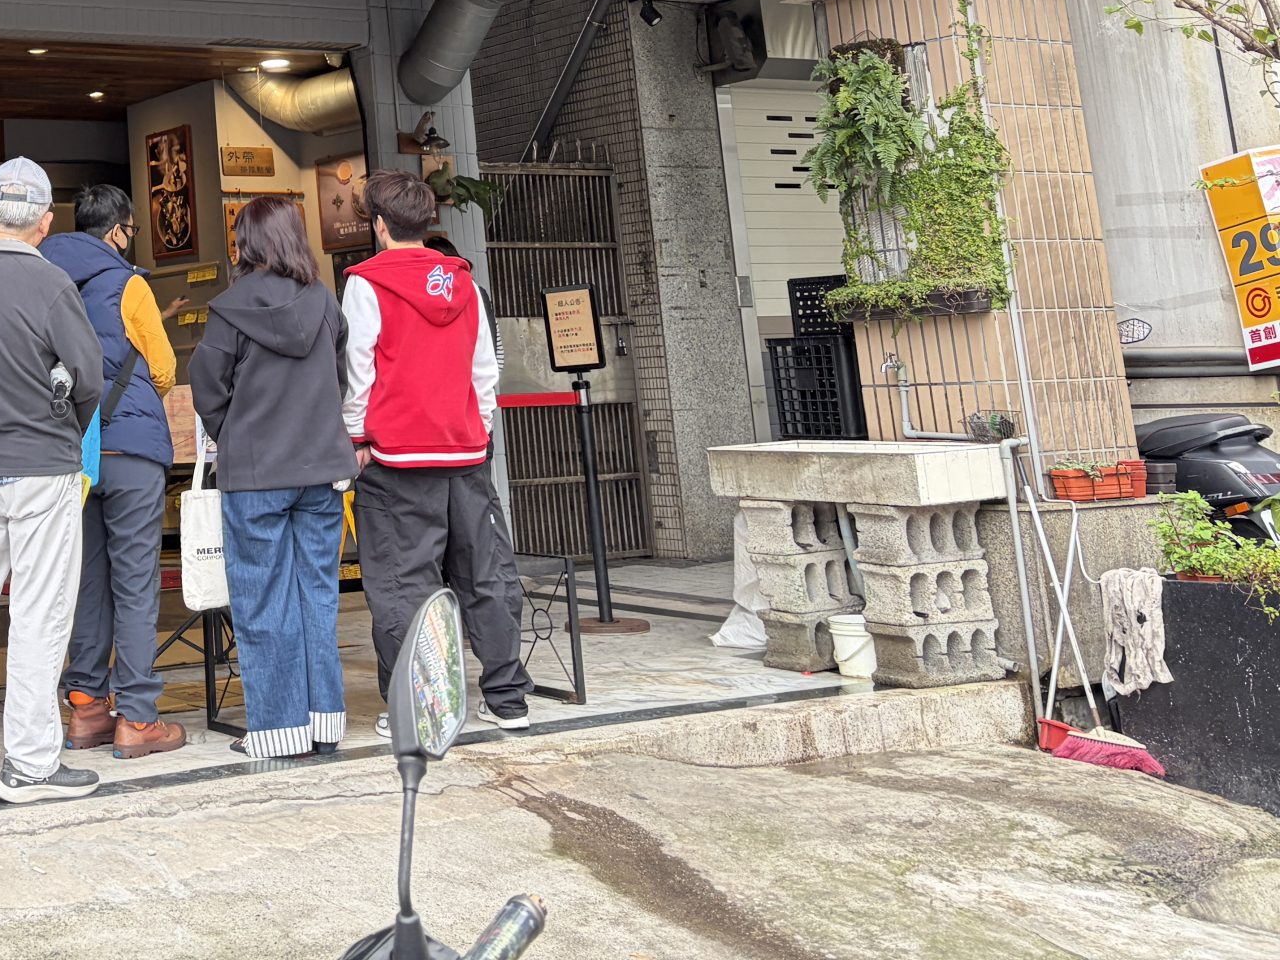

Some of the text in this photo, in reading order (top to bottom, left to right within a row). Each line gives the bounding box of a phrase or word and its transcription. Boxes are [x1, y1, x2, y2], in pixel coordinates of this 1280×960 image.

[227, 150, 255, 164] 外帶
[1248, 325, 1278, 345] 首創
[196, 546, 224, 555] MER
